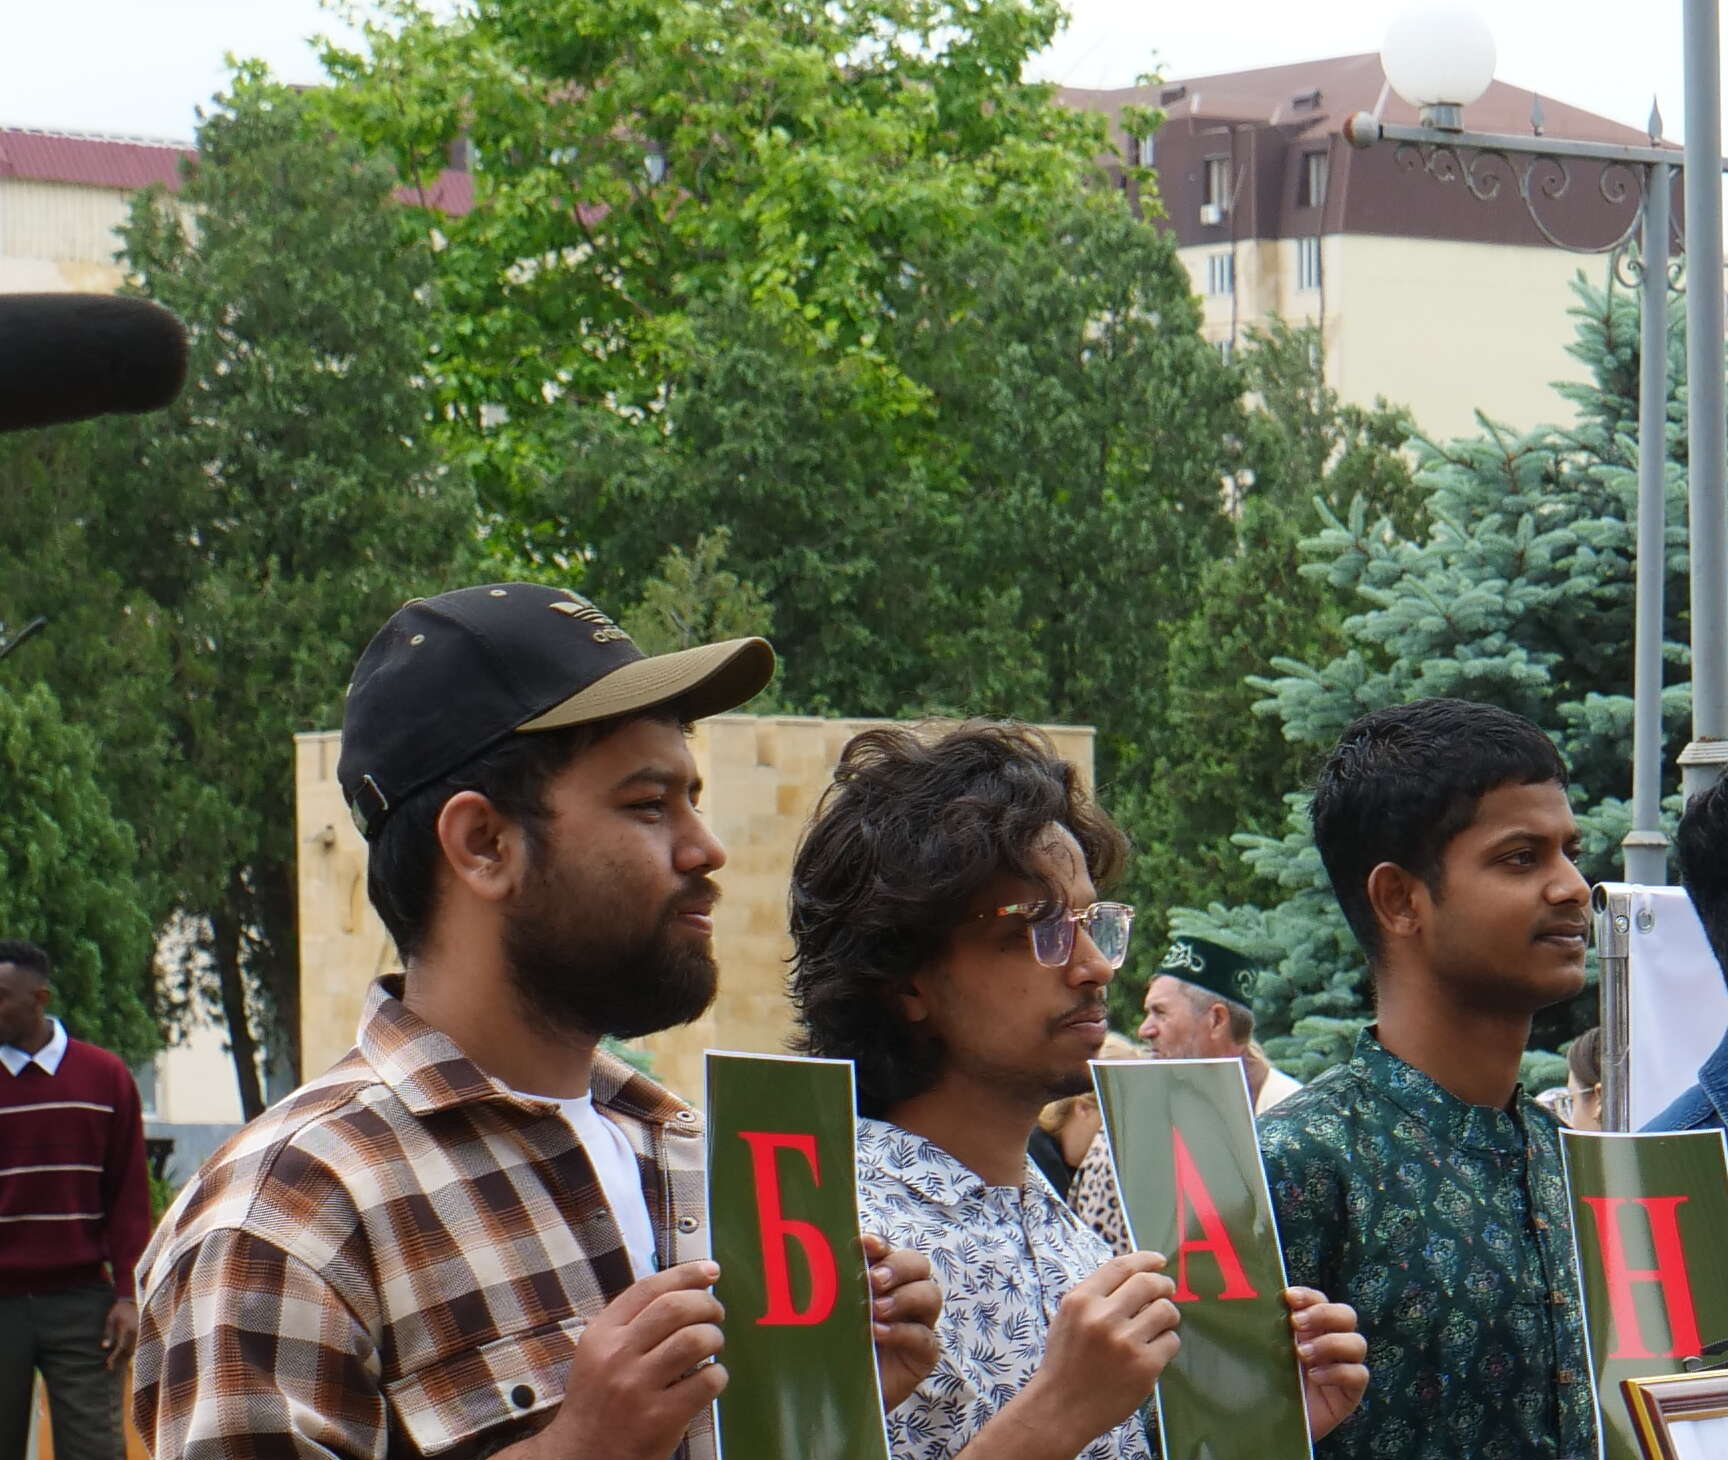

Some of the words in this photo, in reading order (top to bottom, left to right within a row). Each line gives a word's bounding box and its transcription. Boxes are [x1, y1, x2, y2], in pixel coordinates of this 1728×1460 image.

[737, 1131, 838, 1326] Б
[1169, 1127, 1259, 1303] А
[1581, 1195, 1704, 1359] Н
